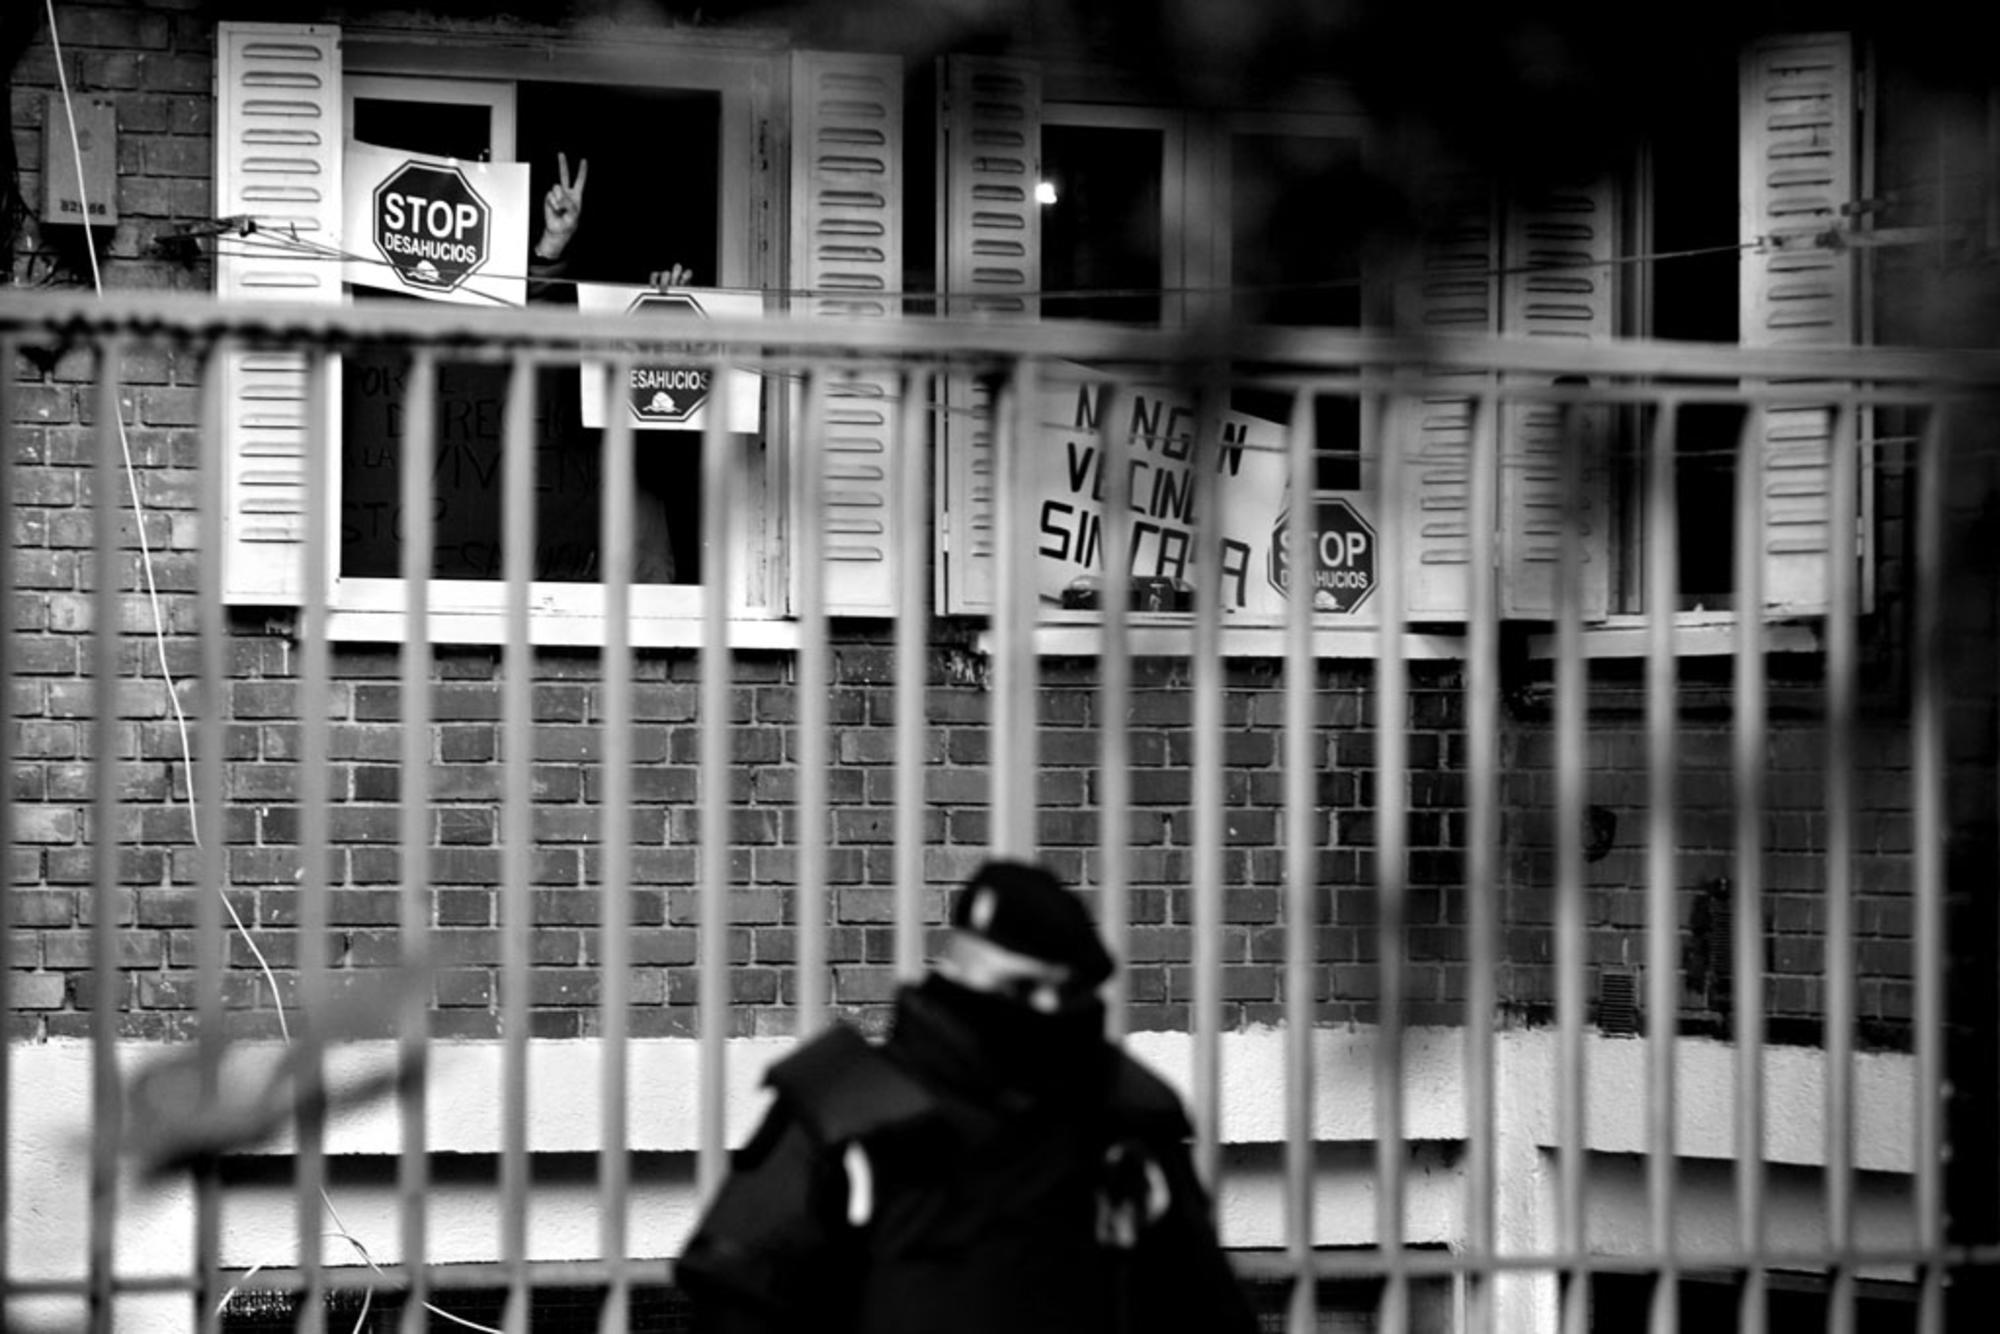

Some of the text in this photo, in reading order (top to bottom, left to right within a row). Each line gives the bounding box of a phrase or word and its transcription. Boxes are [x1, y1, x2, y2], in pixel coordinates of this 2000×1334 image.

[384, 192, 479, 240] STOP
[384, 232, 477, 264] DESAHUCIOS
[630, 369, 709, 390] ESAHUCIOS
[1076, 382, 1247, 477] NNGN
[1130, 521, 1251, 607] CAA
[1280, 530, 1366, 567] OP
